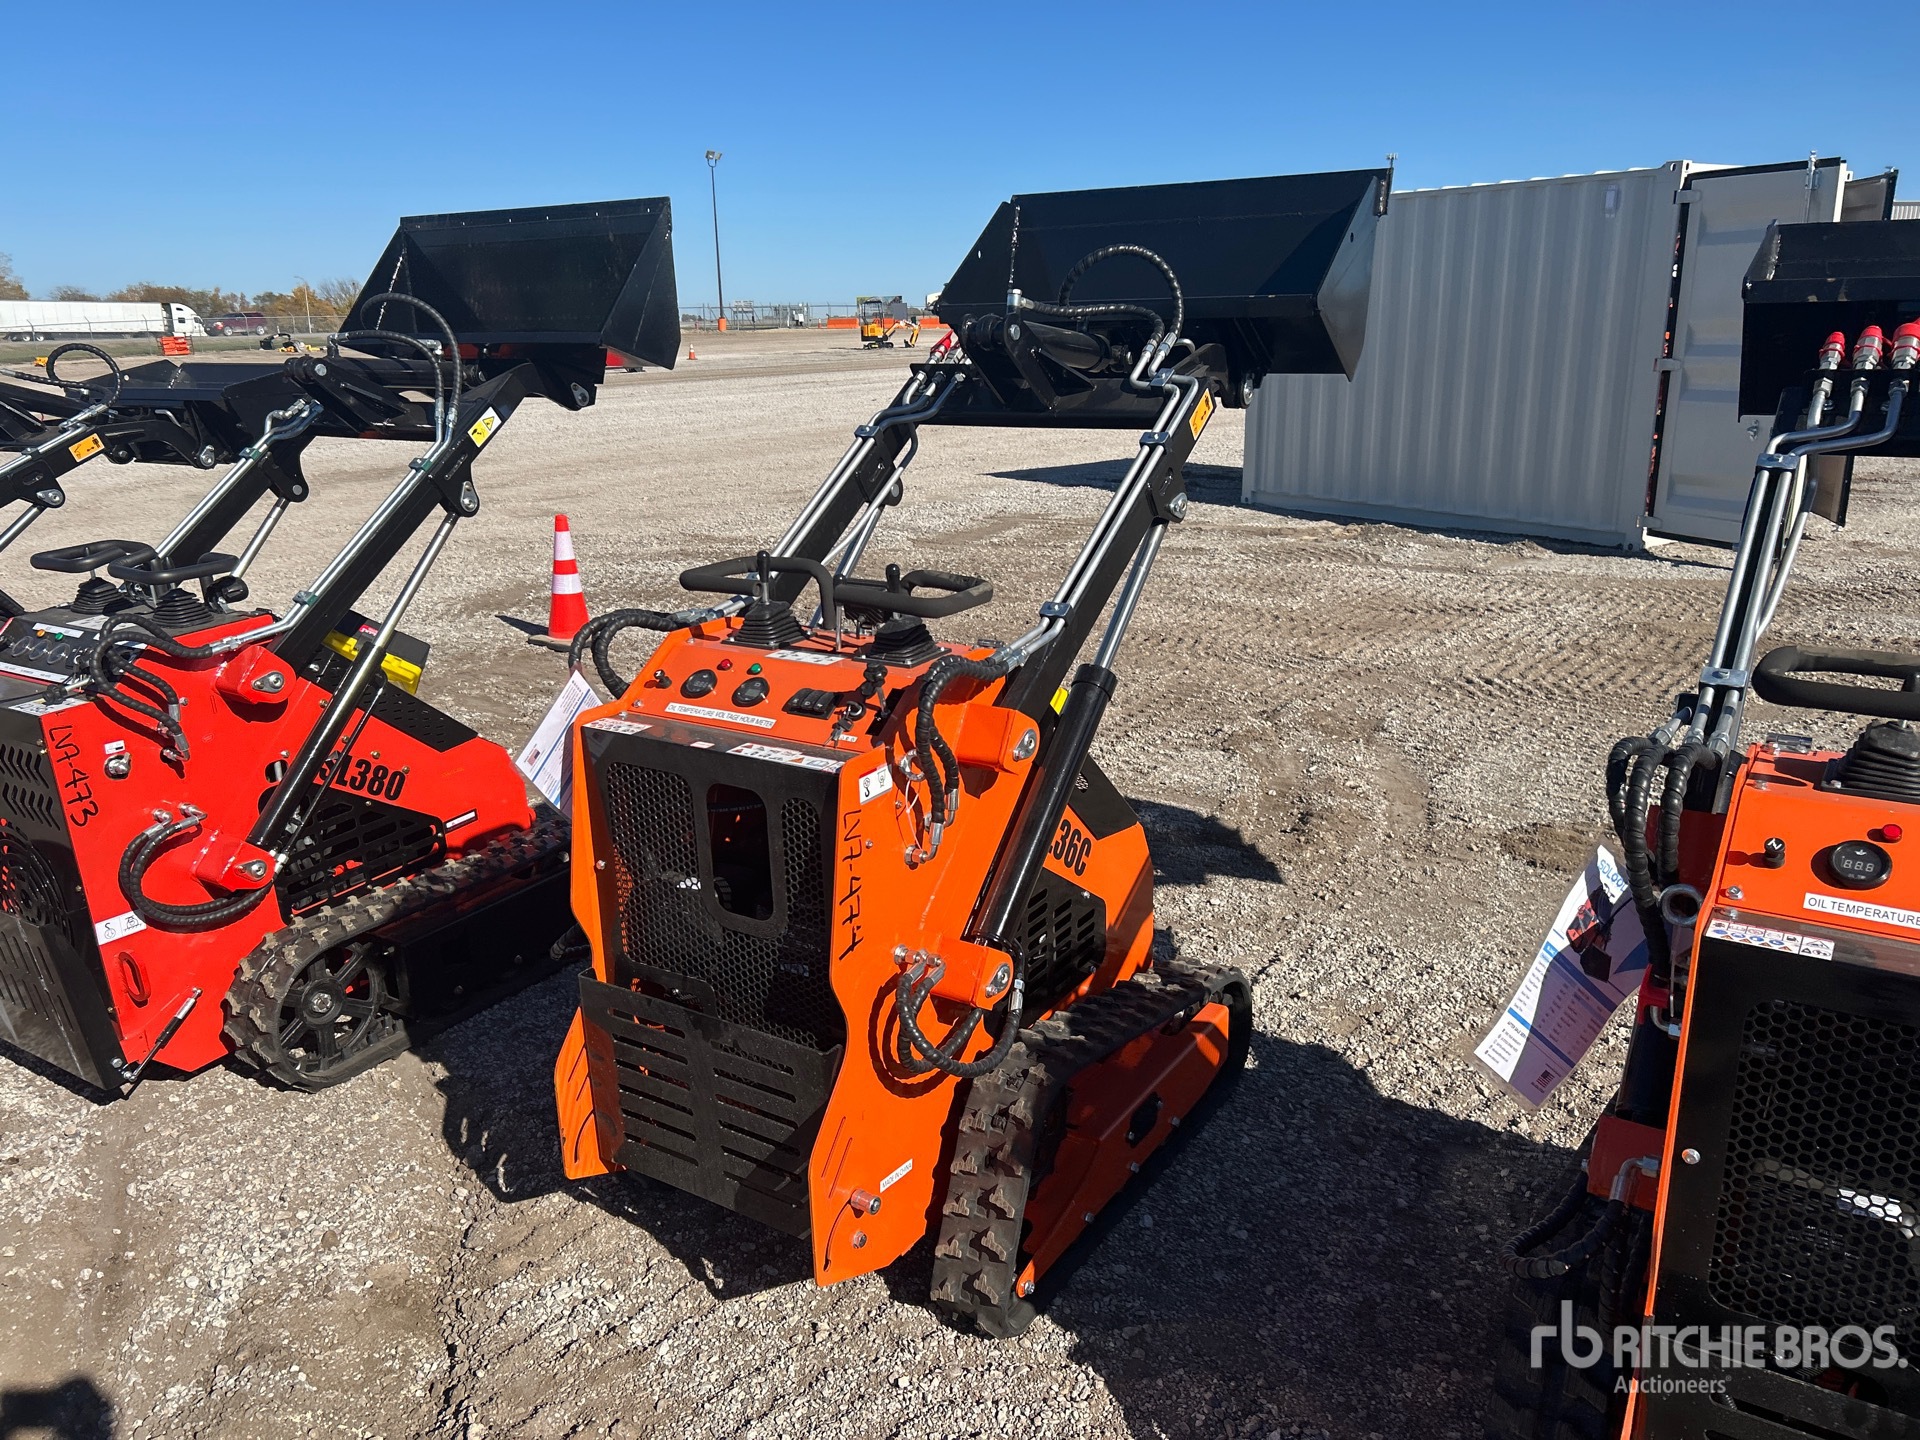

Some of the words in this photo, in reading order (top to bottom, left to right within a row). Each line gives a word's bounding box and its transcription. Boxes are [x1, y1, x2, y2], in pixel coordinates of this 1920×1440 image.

[678, 705, 715, 717] TEMPERATURE
[740, 715, 756, 723] HOUR
[756, 718, 773, 727] METER
[1048, 818, 1092, 877] 36C
[1807, 897, 1828, 909] OIL
